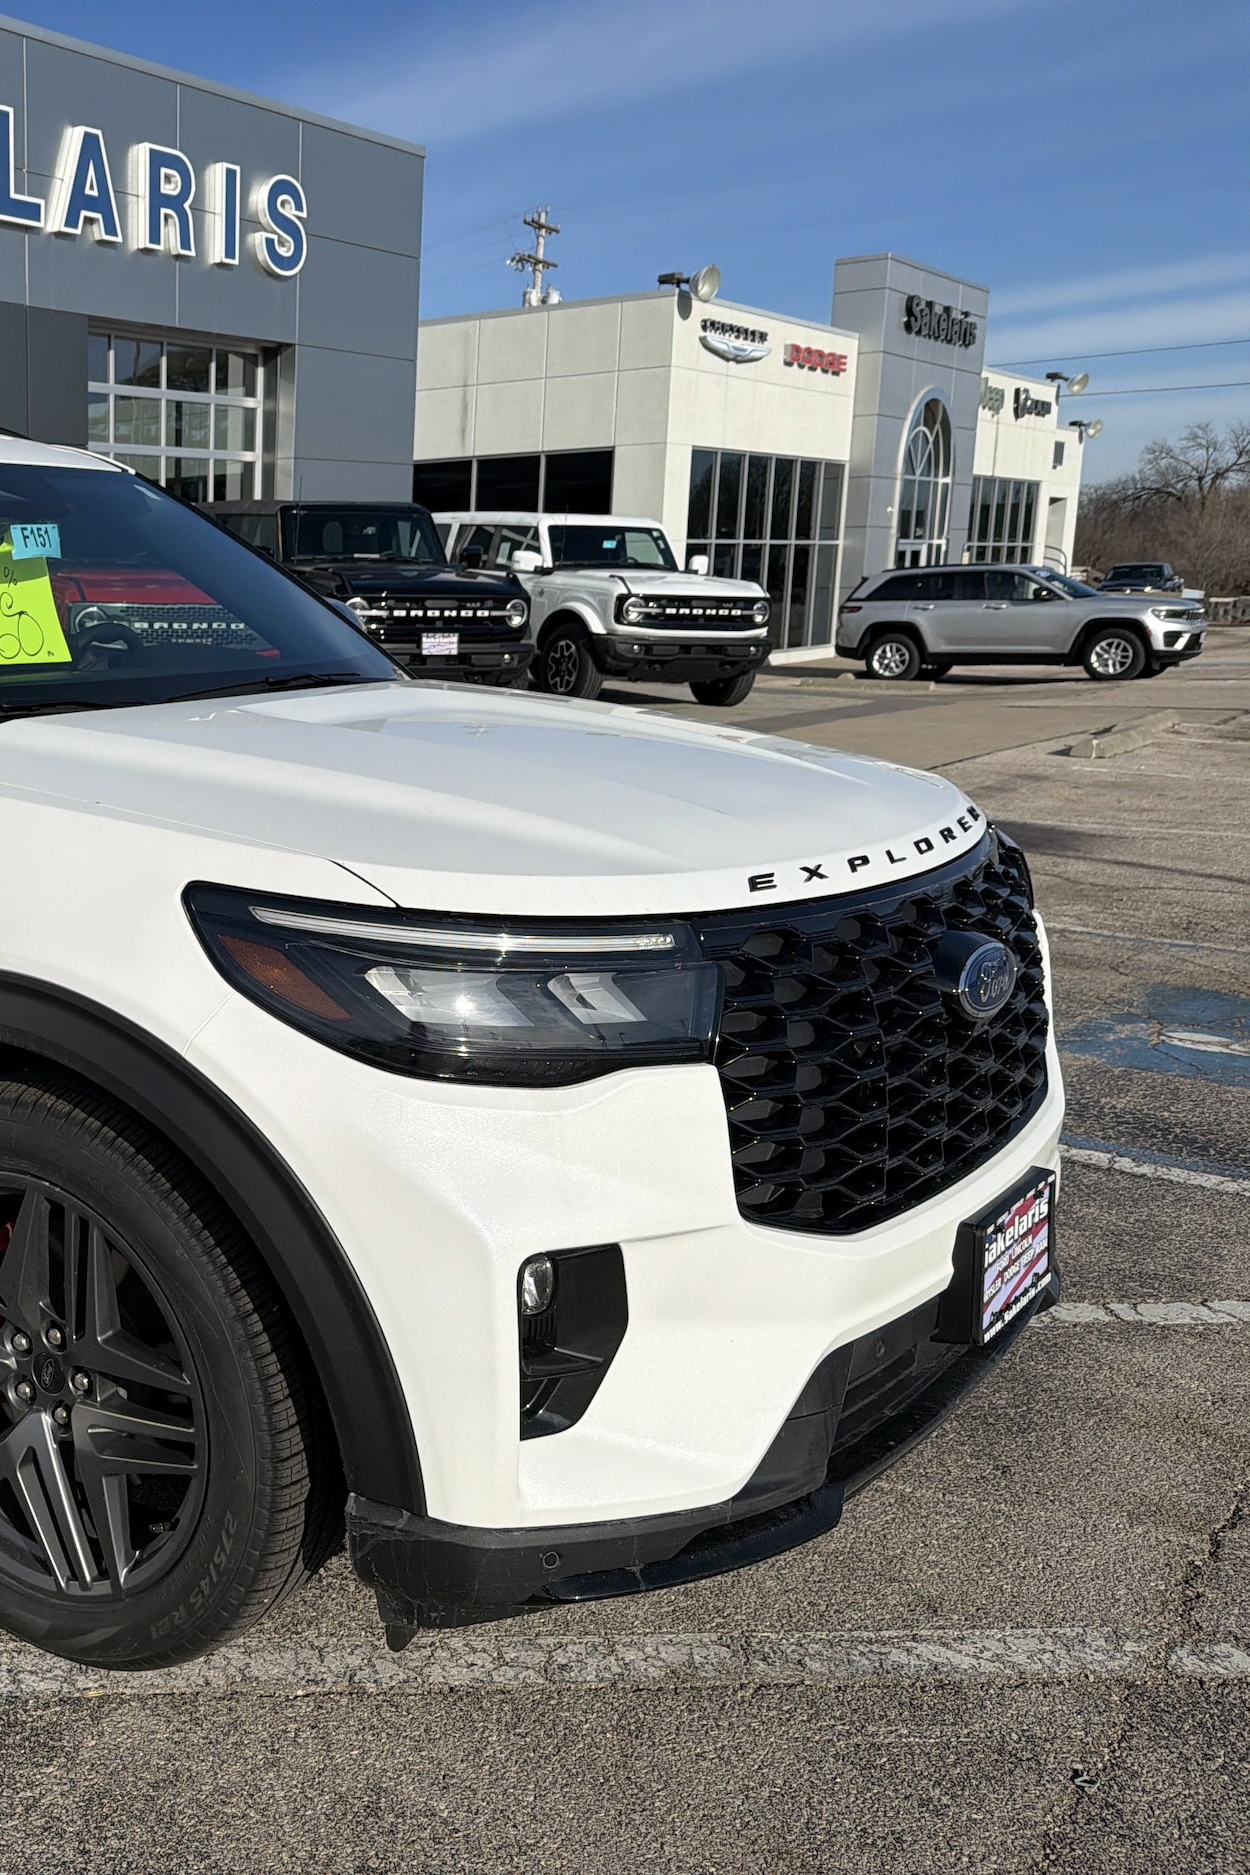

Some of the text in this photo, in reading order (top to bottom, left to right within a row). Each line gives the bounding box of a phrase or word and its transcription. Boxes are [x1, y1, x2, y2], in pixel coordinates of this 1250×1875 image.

[903, 295, 978, 348] Sakelaris
[785, 343, 848, 375] DODGE
[20, 526, 52, 548] F151
[393, 609, 490, 617] BRONCO
[665, 608, 742, 616] BRONCO
[133, 621, 245, 630] BRONCO
[748, 805, 981, 893] EXPLORER
